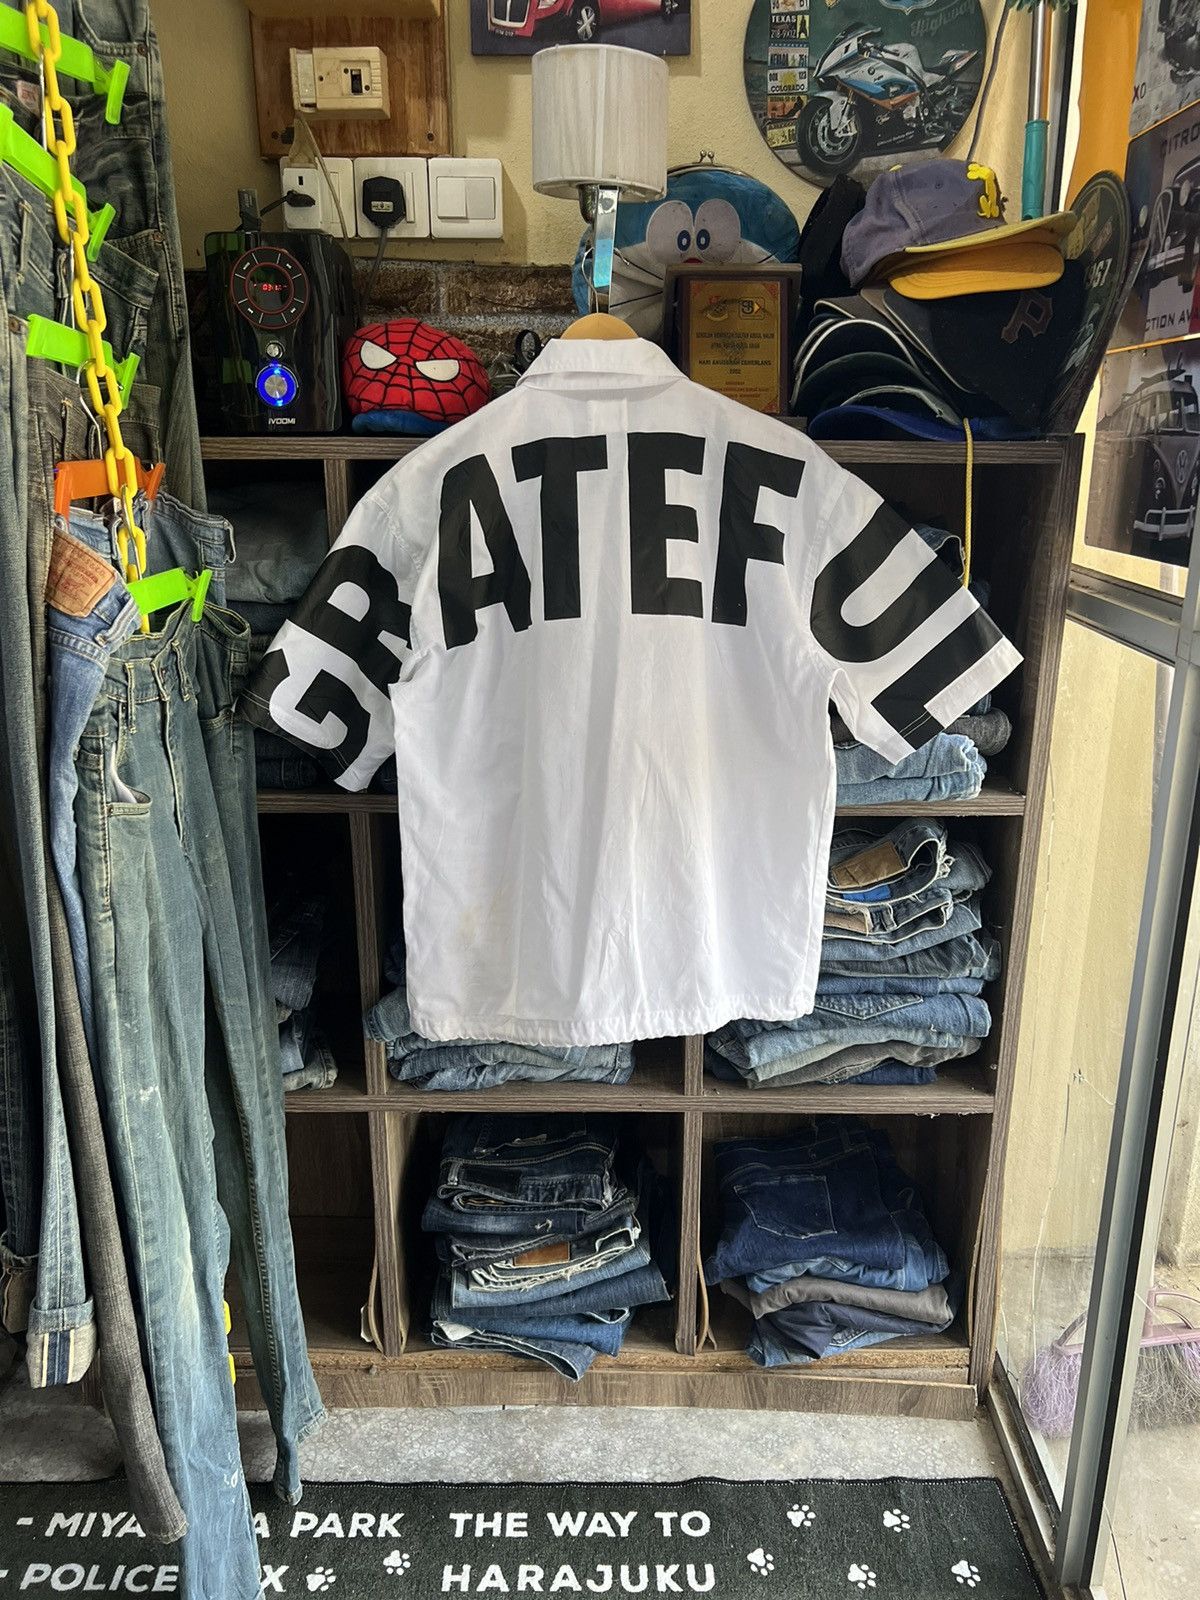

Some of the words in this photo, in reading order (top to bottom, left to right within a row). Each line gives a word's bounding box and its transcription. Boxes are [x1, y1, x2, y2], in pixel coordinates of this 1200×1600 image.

[771, 15, 797, 23] TEXAS
[770, 83, 805, 93] COLORADO
[236, 431, 1007, 781] GRATEFUL
[44, 1511, 270, 1539] MIYAA
[290, 1511, 405, 1538] PARK
[449, 1511, 529, 1538] THE
[546, 1511, 638, 1538] WAY
[654, 1510, 711, 1537] TO
[19, 1562, 179, 1593] POLICE
[441, 1563, 716, 1593] HARAJUKU
